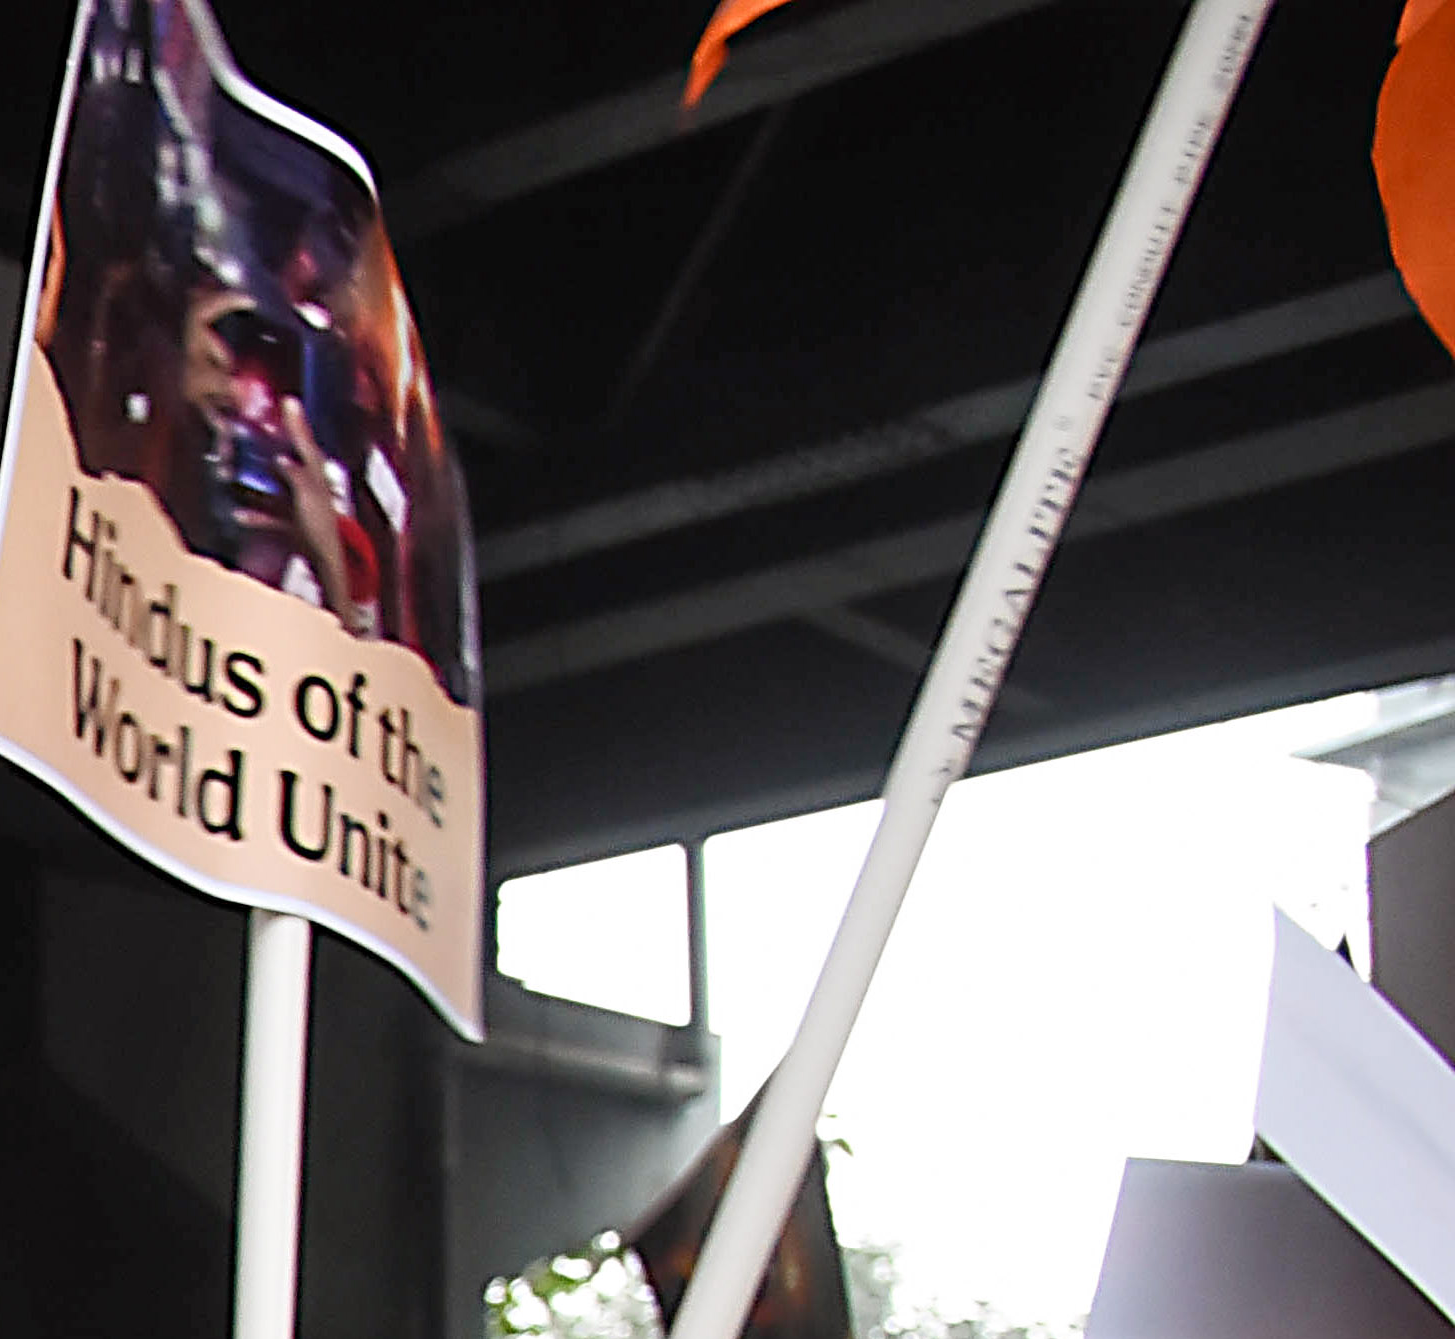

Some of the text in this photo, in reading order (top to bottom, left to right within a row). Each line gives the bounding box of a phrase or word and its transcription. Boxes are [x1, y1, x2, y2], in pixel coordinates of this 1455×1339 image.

[60, 485, 265, 719] Hindus
[294, 670, 367, 759] of
[70, 637, 246, 843] World
